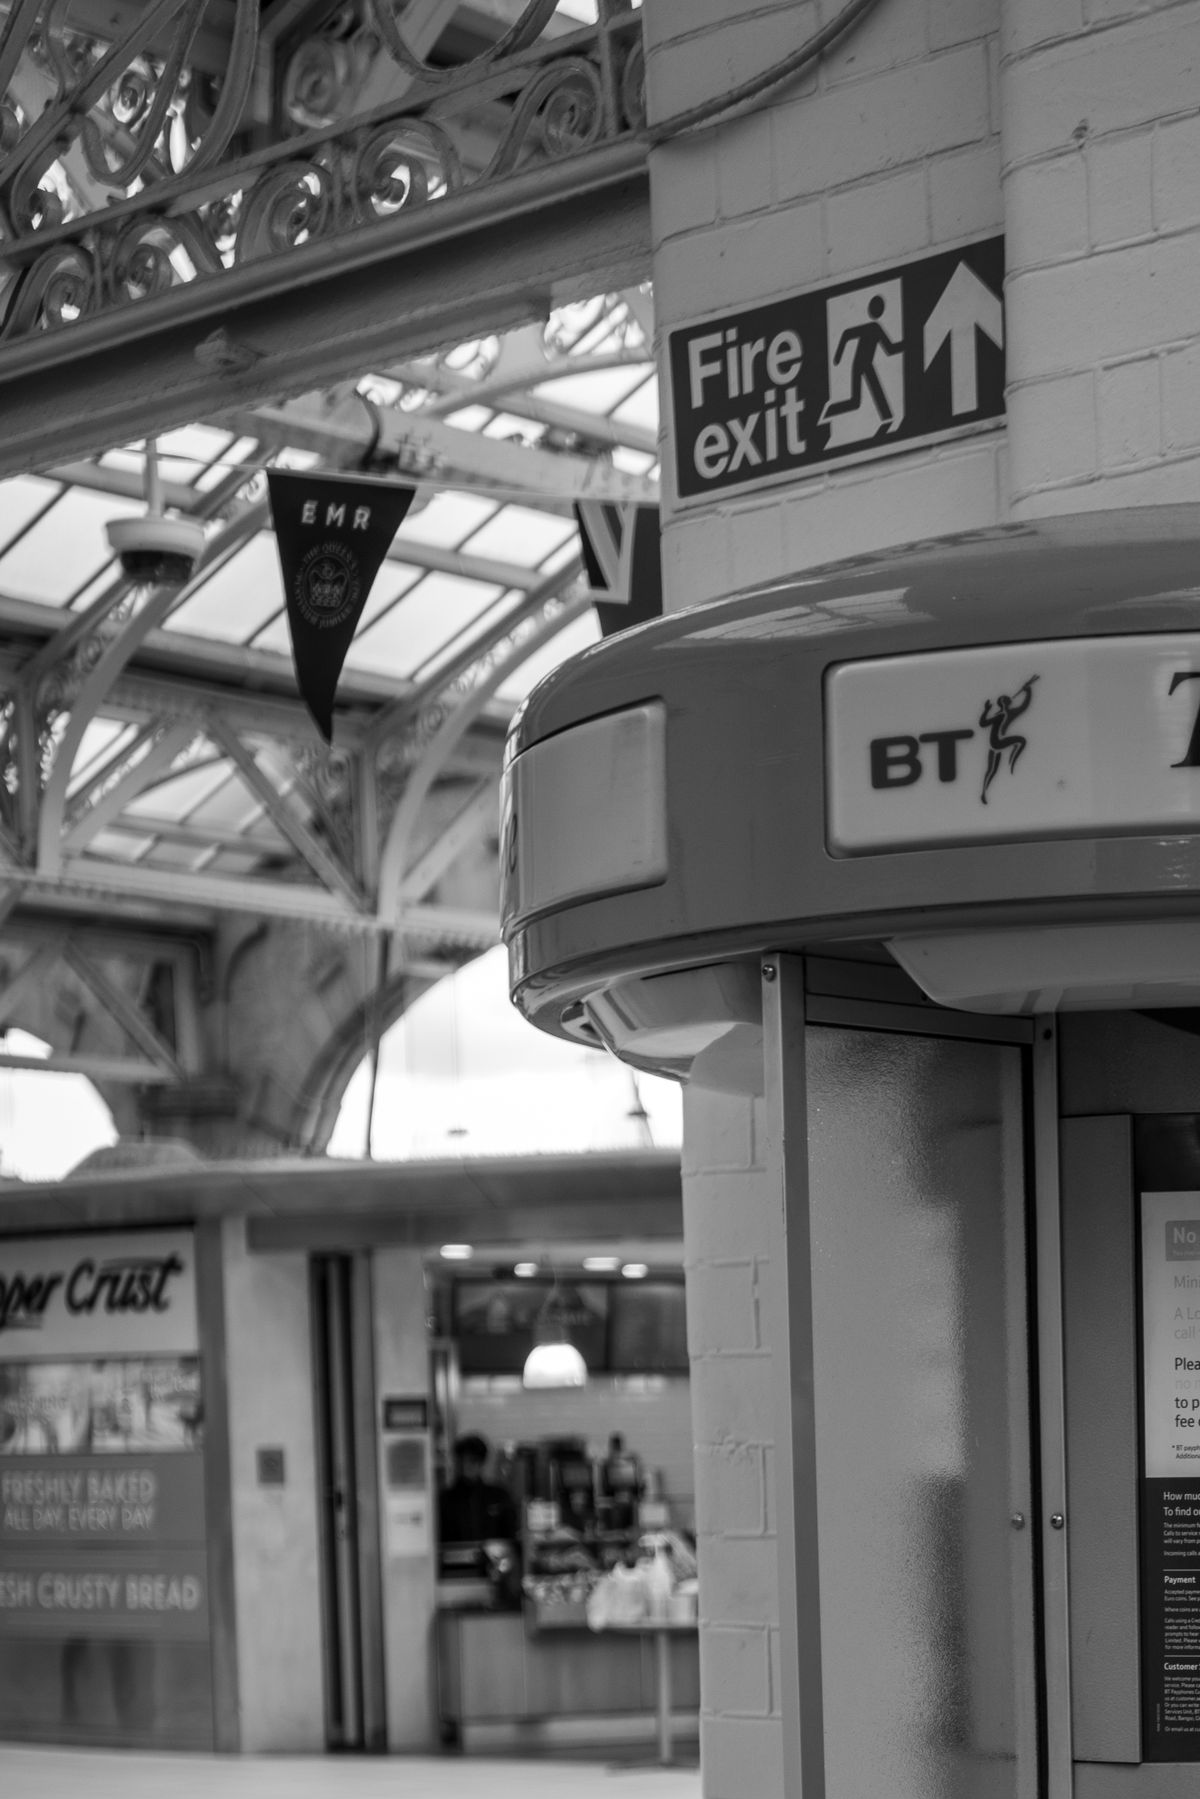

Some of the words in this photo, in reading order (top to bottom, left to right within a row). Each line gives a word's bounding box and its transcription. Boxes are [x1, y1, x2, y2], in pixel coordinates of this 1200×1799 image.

[688, 327, 802, 409] Fire
[694, 387, 806, 479] exit
[302, 500, 371, 531] EMR
[870, 729, 974, 789] BT
[1173, 1227, 1197, 1243] No
[65, 1253, 184, 1316] Crust
[1174, 1307, 1184, 1320] A
[1174, 1326, 1196, 1339] call
[1175, 1380, 1192, 1390] no
[1175, 1397, 1188, 1409] to
[1175, 1415, 1194, 1428] fee
[2, 1471, 82, 1504] FRESHLY
[87, 1470, 156, 1503] BAKED
[1163, 1491, 1182, 1501] How
[5, 1507, 32, 1530] ALL
[68, 1506, 116, 1530] EVERY
[121, 1506, 154, 1530] DAY
[1163, 1507, 1173, 1516] To
[1175, 1507, 1191, 1516] find
[1164, 1576, 1196, 1584] Payment
[37, 1572, 120, 1609] CRUSTY
[126, 1574, 200, 1610] BREAD
[1164, 1662, 1197, 1671] Customer
